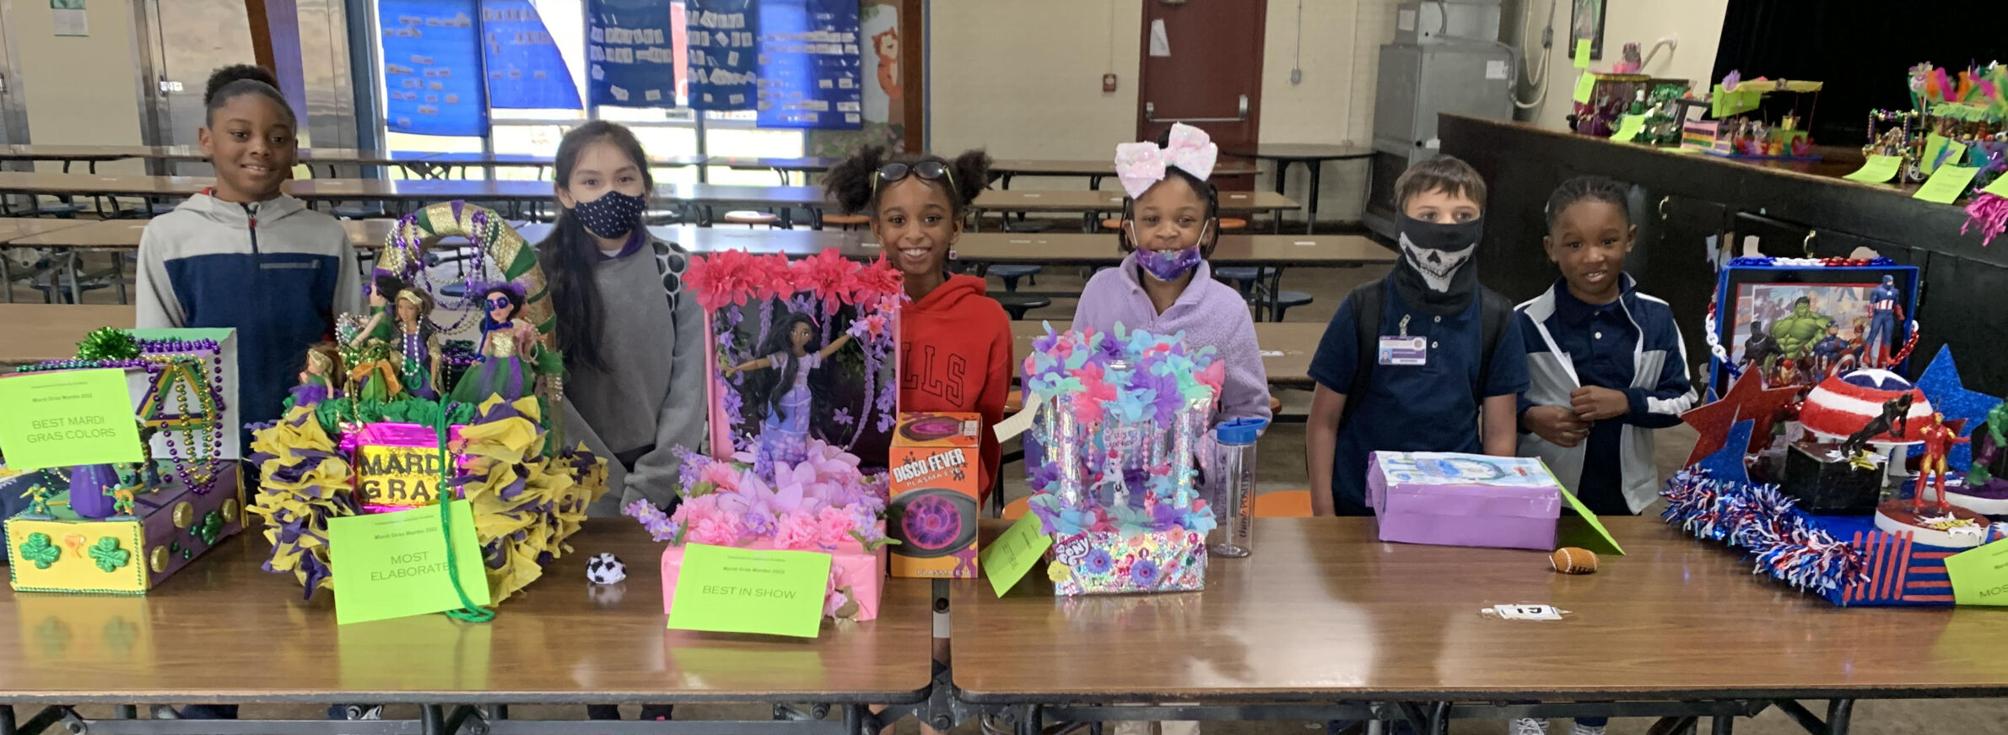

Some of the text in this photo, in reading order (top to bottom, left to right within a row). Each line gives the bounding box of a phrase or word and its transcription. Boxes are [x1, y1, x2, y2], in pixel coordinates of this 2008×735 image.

[32, 415, 105, 430] BEST MARDI
[26, 428, 116, 443] GRAS COLORS
[361, 453, 456, 476] MARDI
[892, 448, 966, 484] DISCO FEVER
[391, 551, 429, 566] MOST
[370, 562, 450, 582] ELABORATE
[702, 584, 797, 600] BEST IN SHOW
